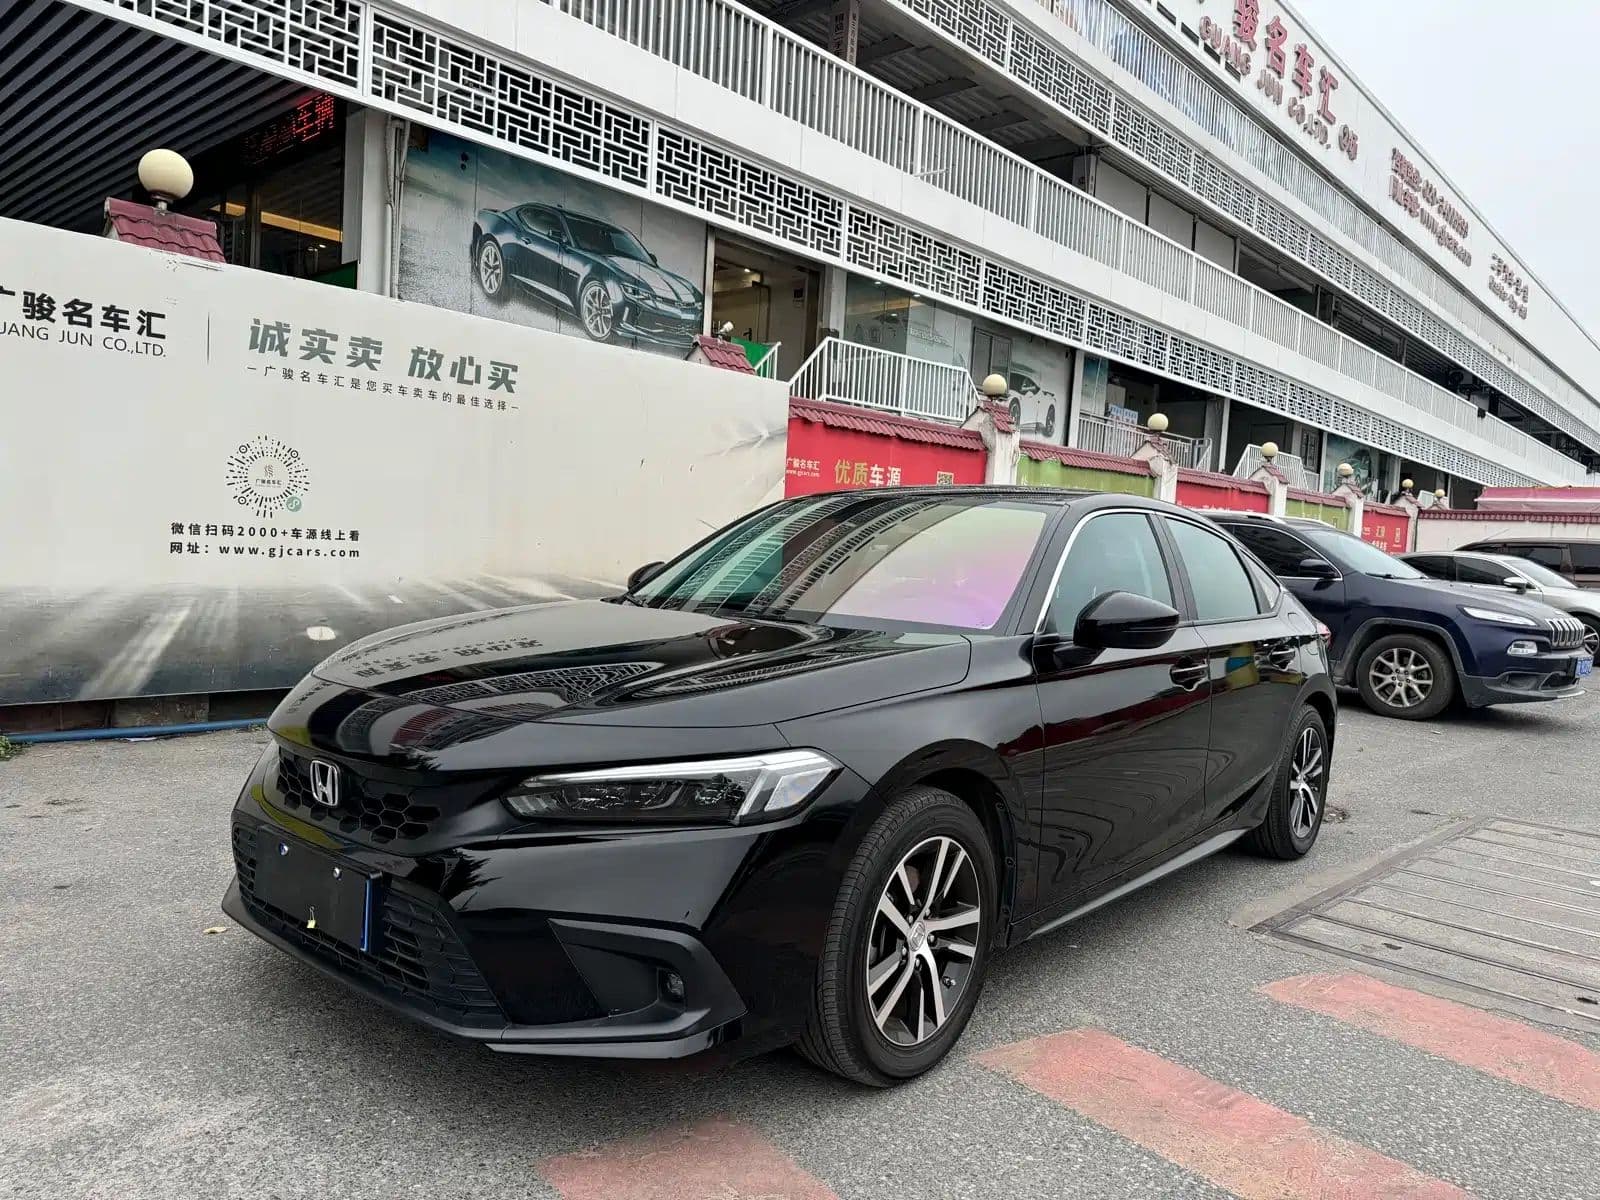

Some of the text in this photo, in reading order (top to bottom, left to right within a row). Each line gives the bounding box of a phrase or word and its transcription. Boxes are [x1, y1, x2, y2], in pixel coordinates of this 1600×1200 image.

[1199, 15, 1251, 76] GUANG
[1257, 69, 1283, 106] JUN
[59, 330, 93, 347] JUN
[102, 337, 167, 358] CO.,LTD.
[249, 318, 519, 393] 诚实卖 放心买
[834, 458, 902, 487] 优质车源
[171, 522, 360, 541] 微信扫码2000+车源线上看
